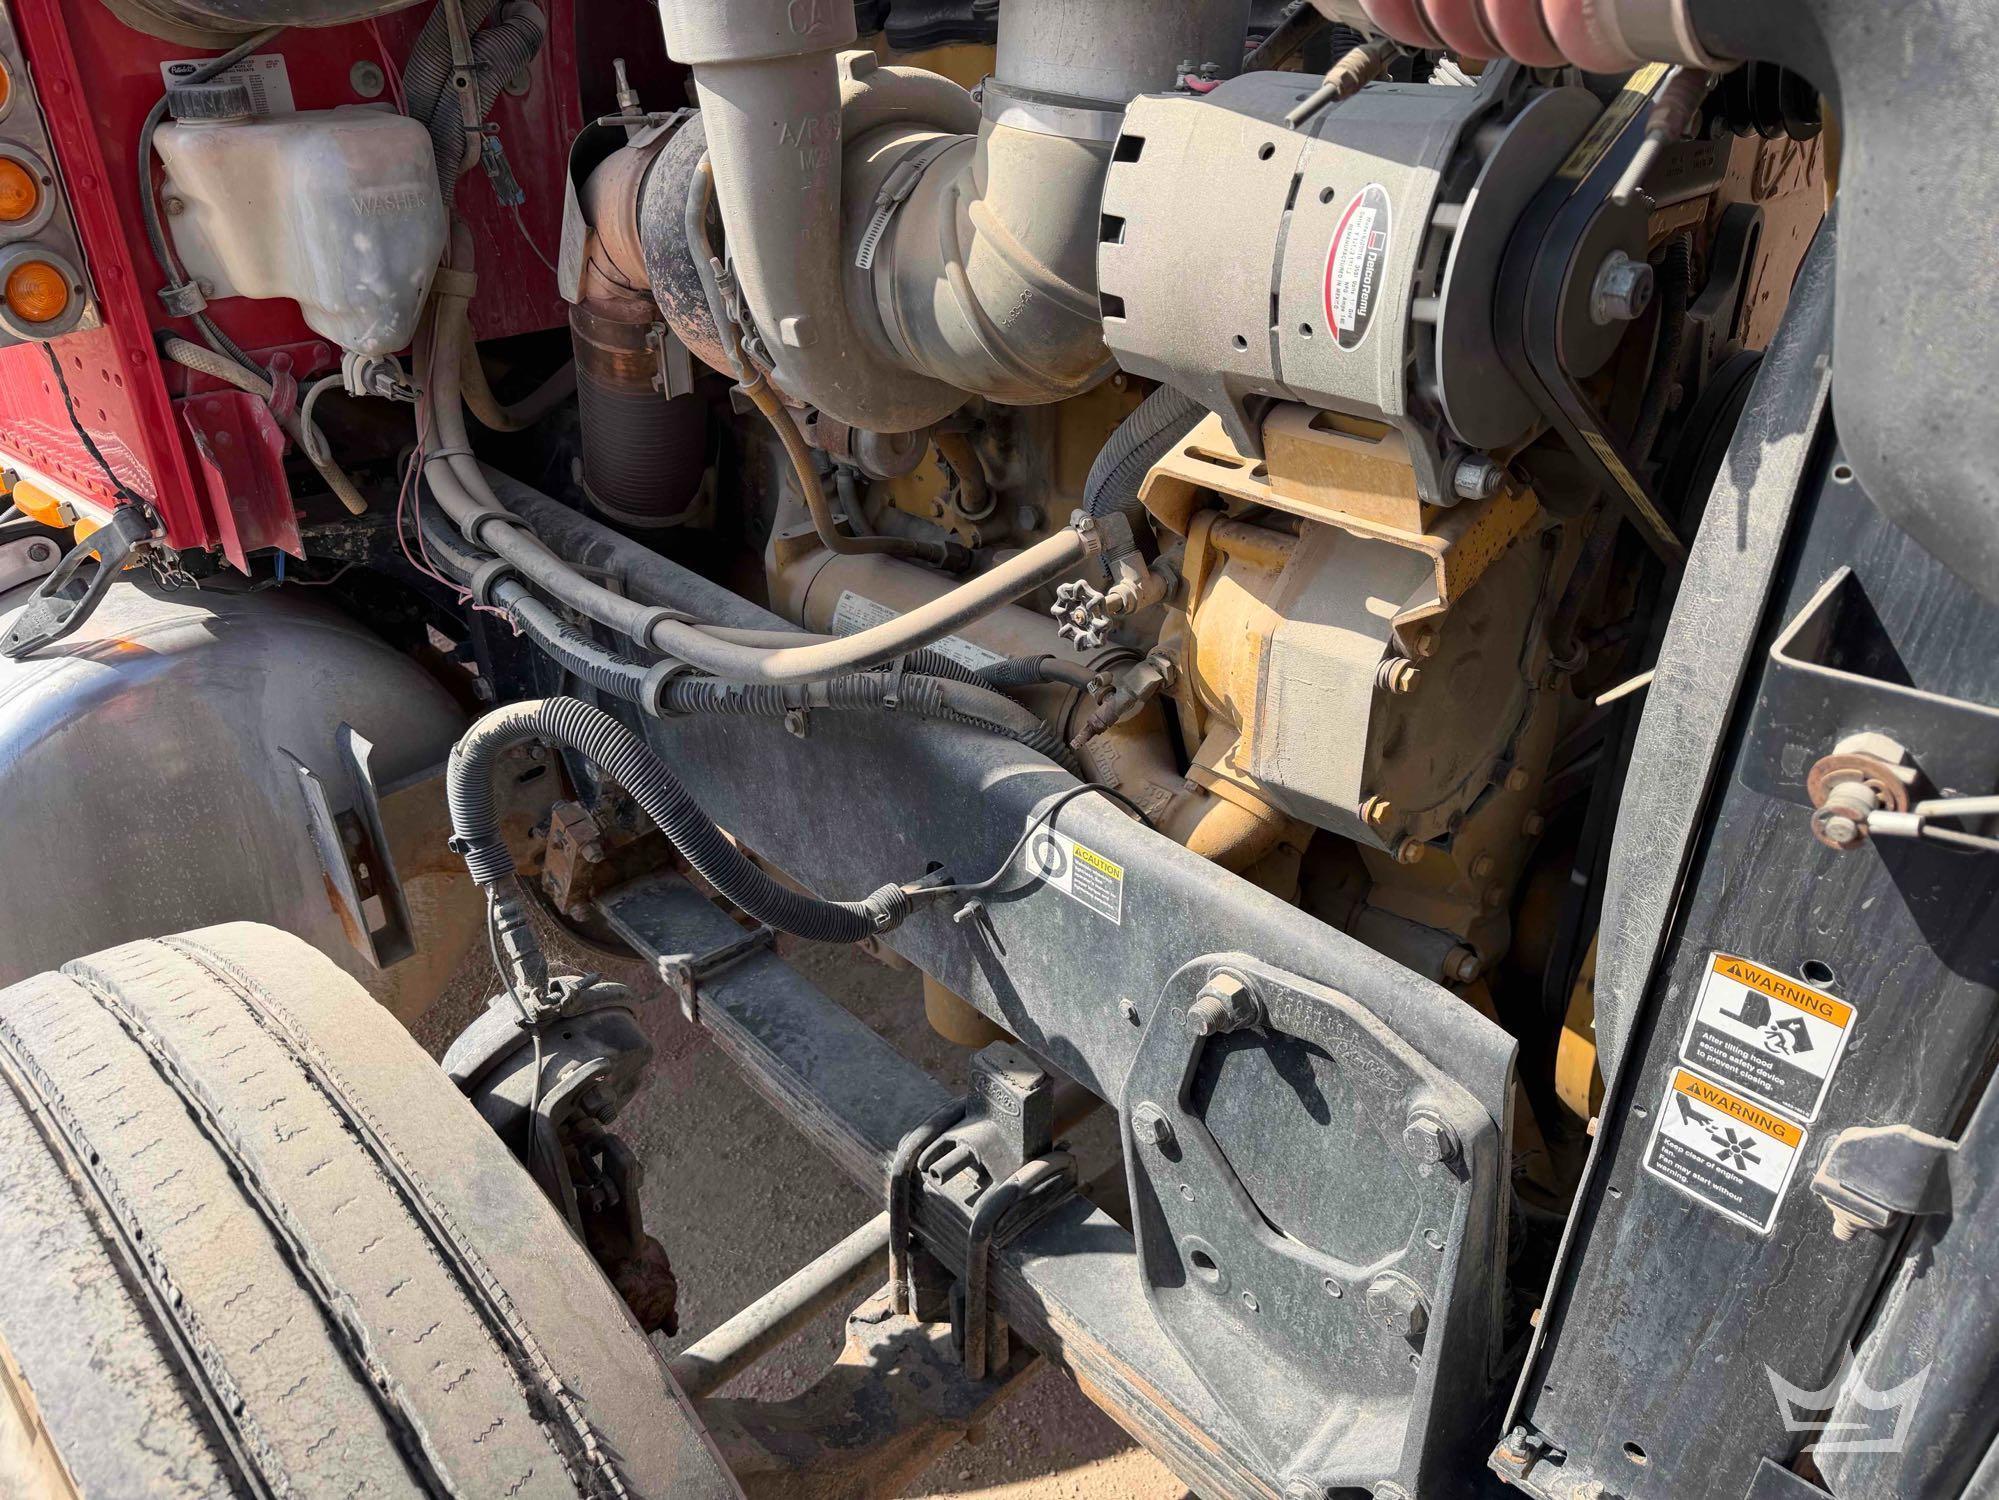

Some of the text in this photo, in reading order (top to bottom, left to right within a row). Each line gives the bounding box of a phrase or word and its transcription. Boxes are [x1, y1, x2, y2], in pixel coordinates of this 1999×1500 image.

[352, 191, 425, 216] WASHER
[1357, 285, 1371, 317] Remy
[1082, 851, 1120, 878] CAUTION
[1745, 968, 1833, 1017] WARNING
[1696, 1049, 1773, 1091] to prevent closing.
[1700, 1041, 1785, 1086] secure safety device
[1702, 1032, 1773, 1070] After tilting hood
[1703, 1088, 1786, 1137] WARNING
[1661, 1146, 1676, 1158] fan.
[1664, 1138, 1744, 1185] Keep clear of engine
[1656, 1162, 1689, 1183] warning.
[1659, 1153, 1743, 1203] Fan may start without
